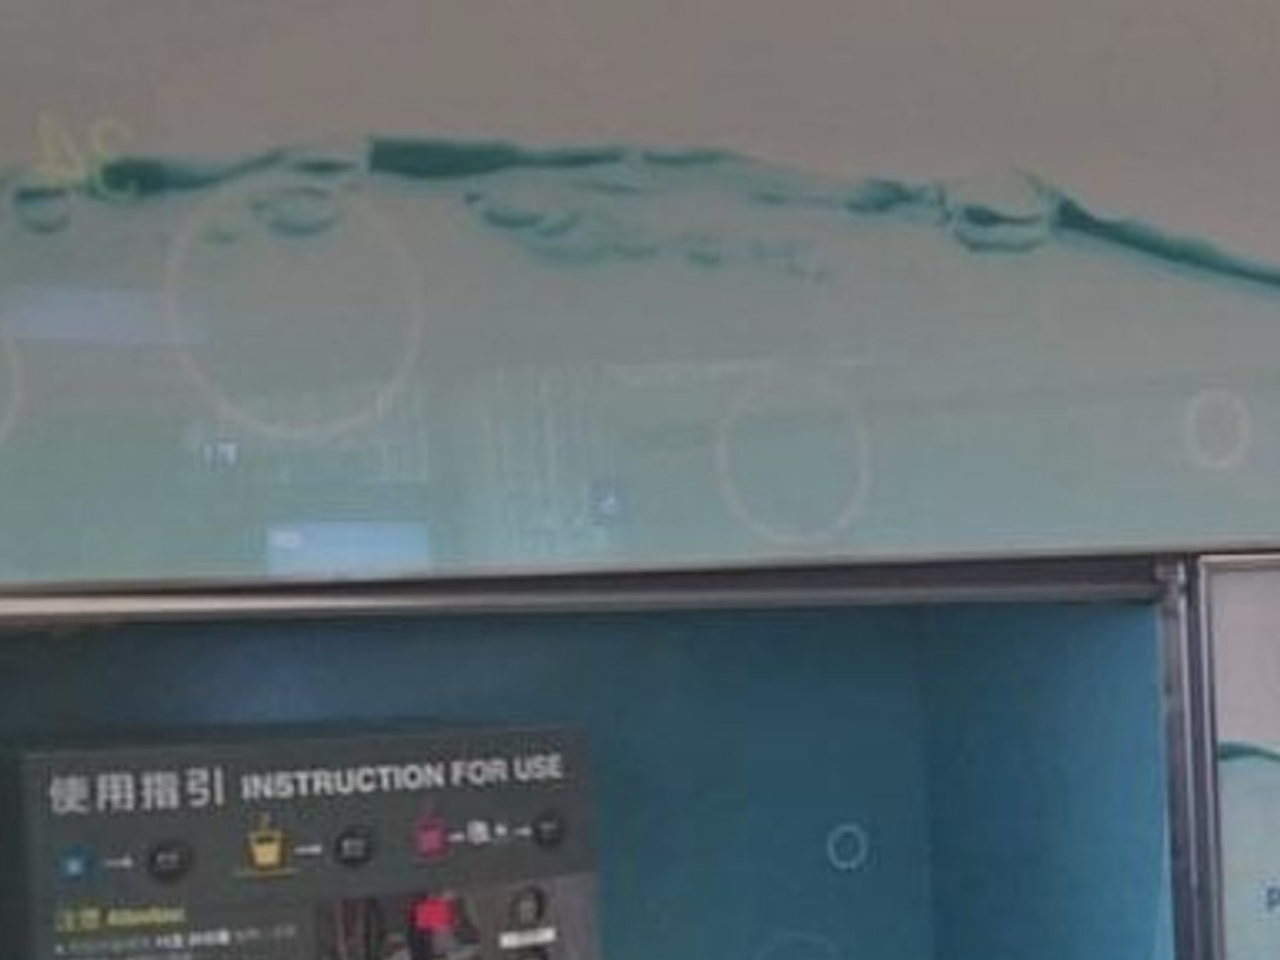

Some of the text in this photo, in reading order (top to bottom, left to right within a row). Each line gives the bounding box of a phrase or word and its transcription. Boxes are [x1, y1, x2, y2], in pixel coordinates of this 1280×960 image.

[50, 769, 223, 813] 使用指引
[241, 754, 564, 800] INSTRUCTION FOR USE
